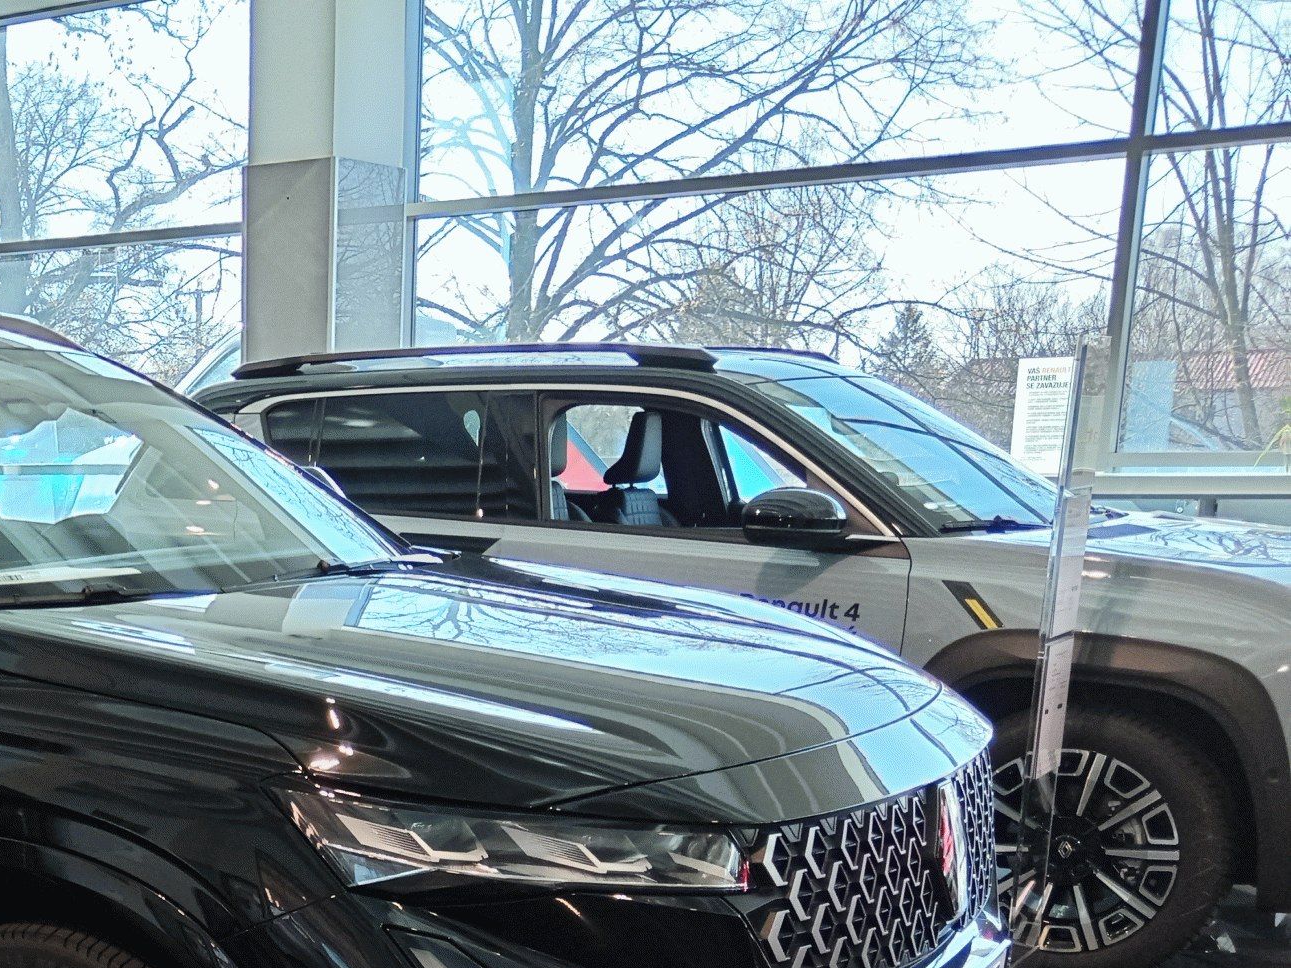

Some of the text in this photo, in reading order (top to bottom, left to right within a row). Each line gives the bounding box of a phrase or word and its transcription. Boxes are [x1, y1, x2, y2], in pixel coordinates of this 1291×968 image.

[1026, 382, 1035, 390] SE
[740, 593, 860, 622] nault 4
